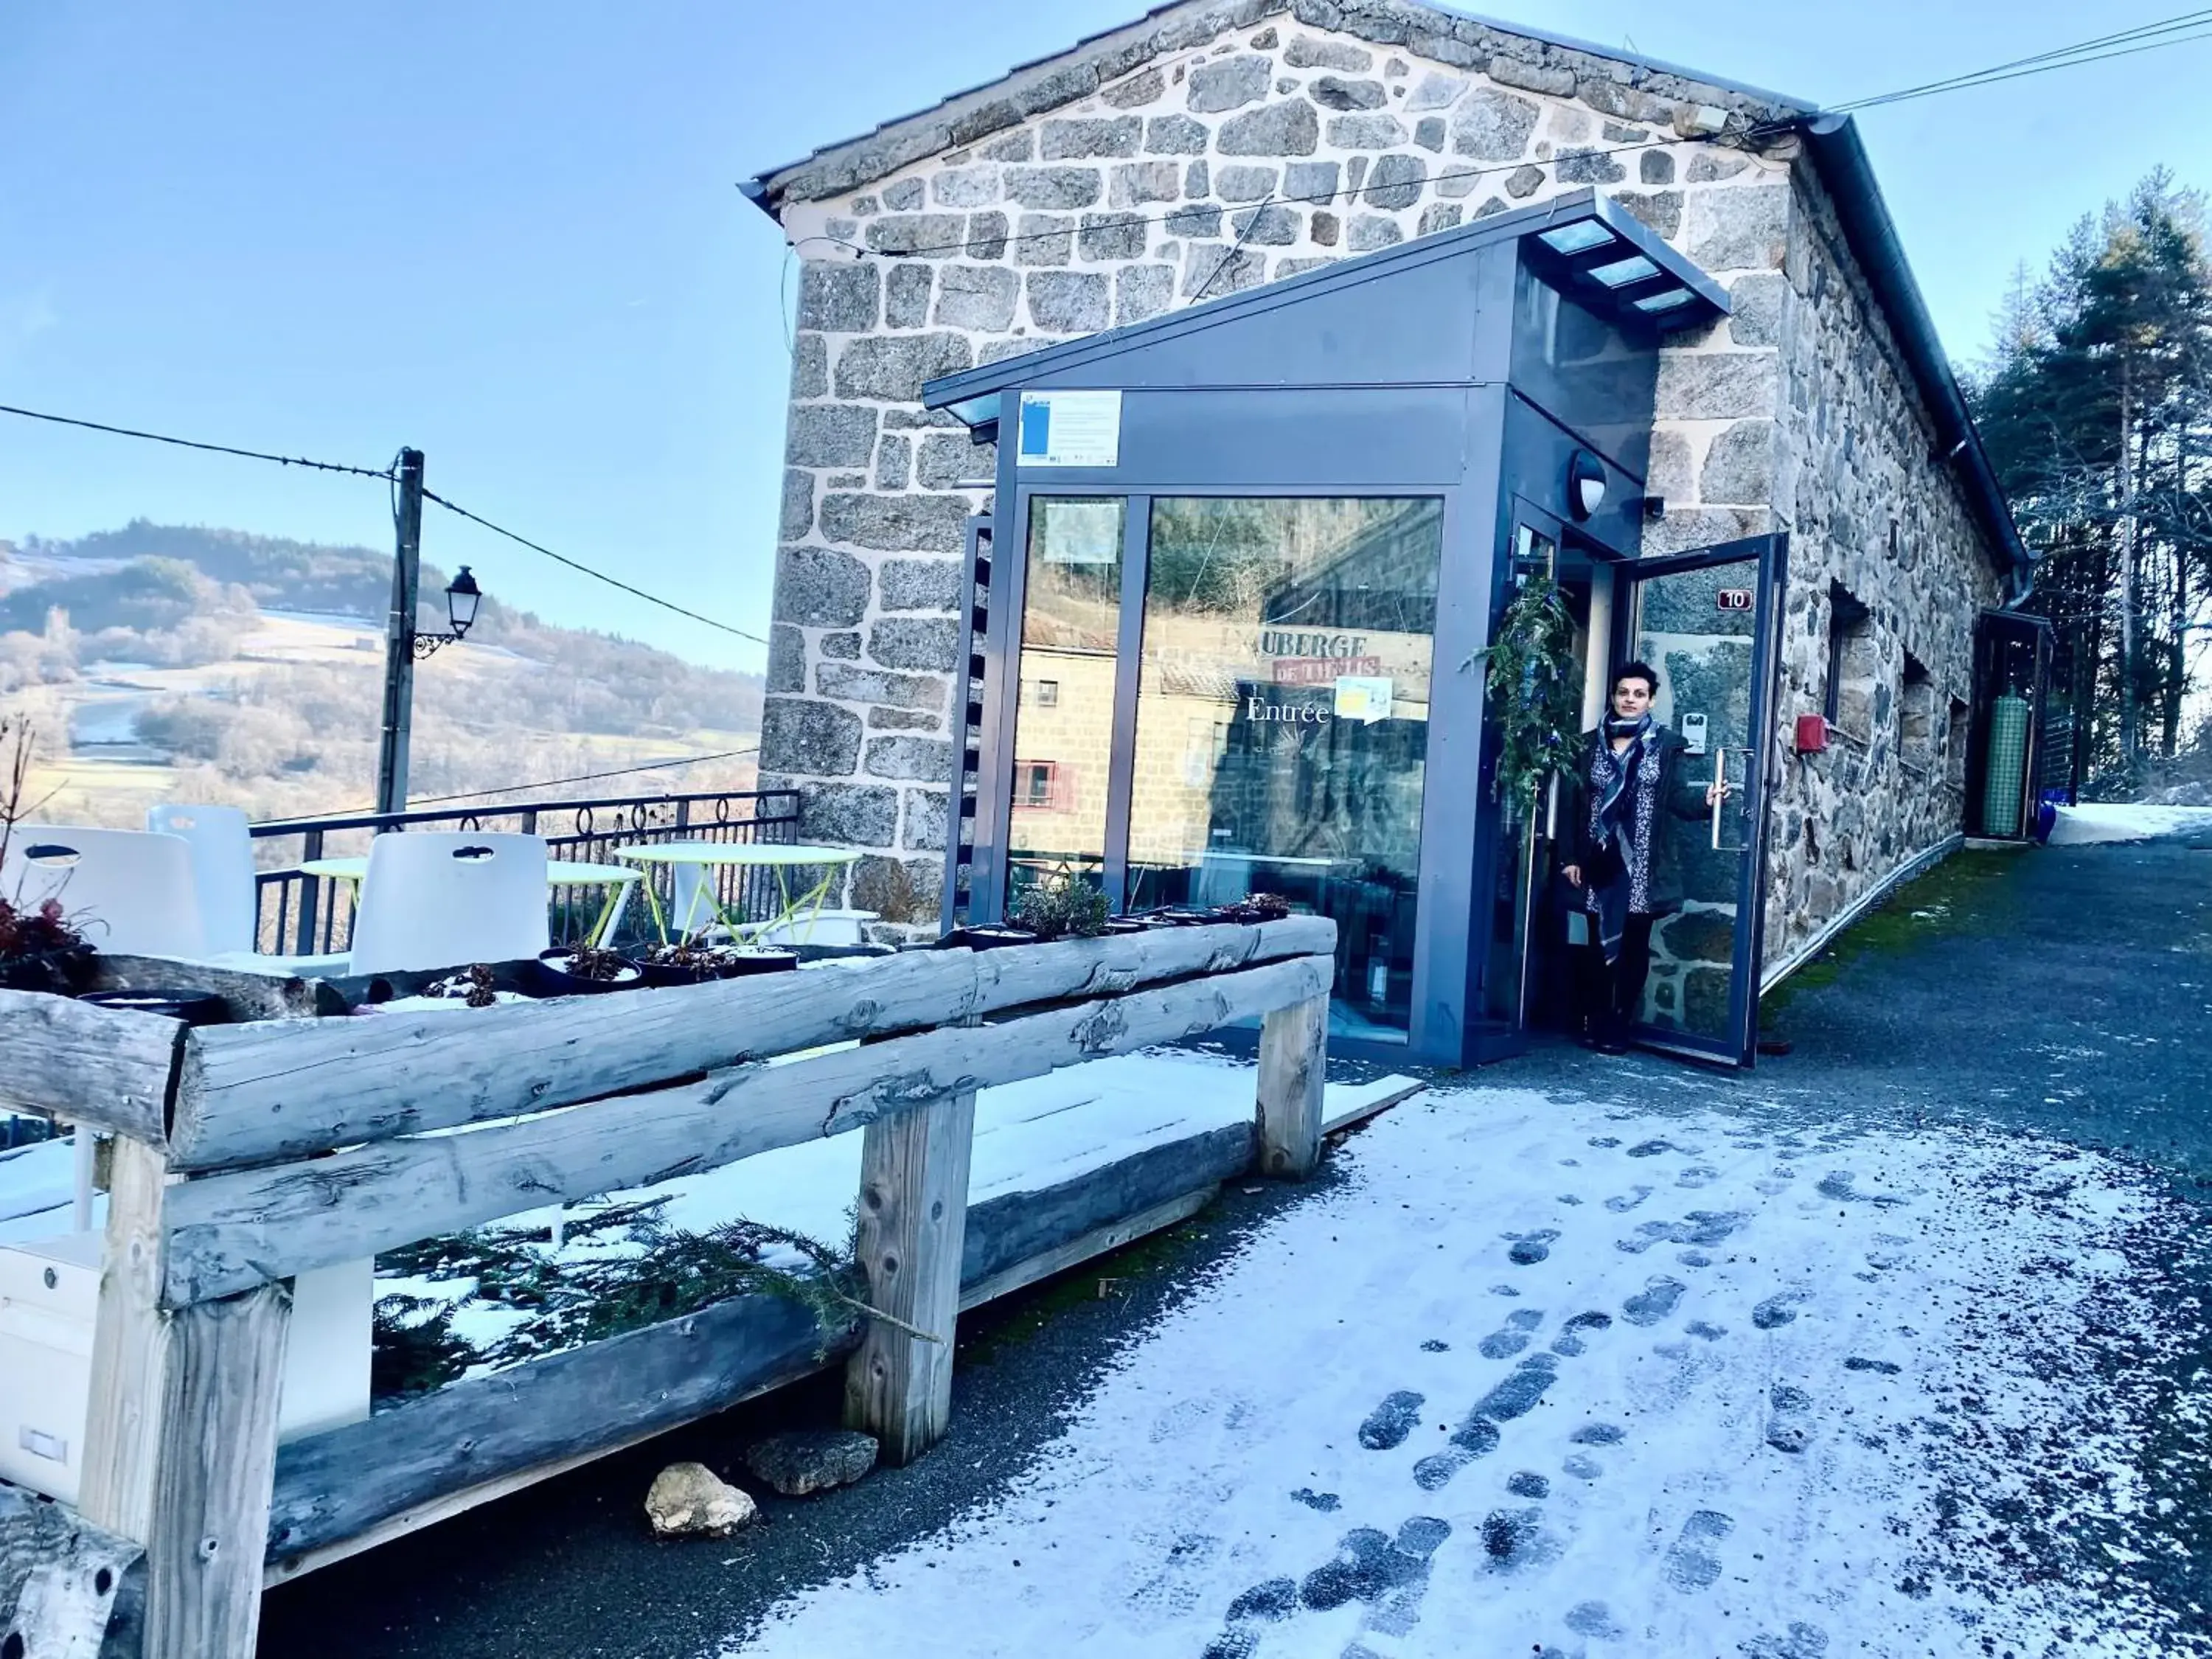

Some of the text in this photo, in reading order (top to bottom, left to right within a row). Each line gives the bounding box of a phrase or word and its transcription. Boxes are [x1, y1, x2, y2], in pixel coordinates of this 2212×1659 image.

[1726, 592, 1745, 607] 10
[1252, 630, 1368, 658] UBERGE
[1276, 667, 1298, 682] DE
[1245, 697, 1329, 723] Entrée
